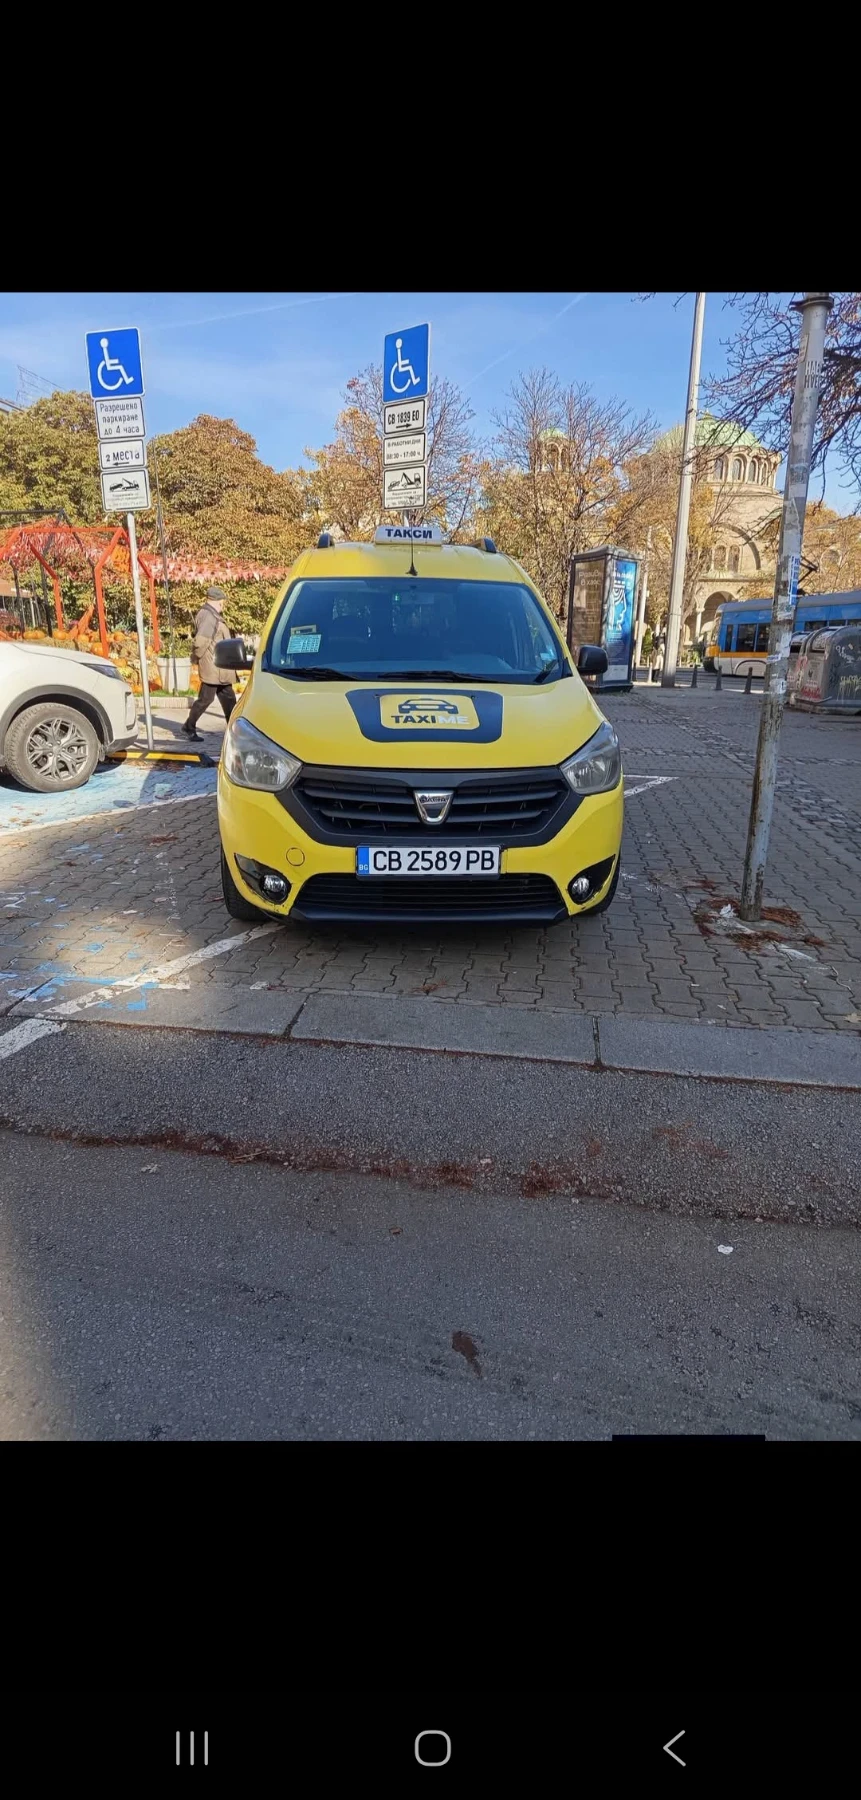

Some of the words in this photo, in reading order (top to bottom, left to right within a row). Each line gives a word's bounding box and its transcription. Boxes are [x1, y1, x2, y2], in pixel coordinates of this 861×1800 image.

[100, 403, 138, 413] Разрешено
[102, 414, 139, 424] паркиране
[388, 414, 396, 424] CB
[397, 411, 411, 424] 1839
[104, 428, 113, 436] до
[116, 425, 120, 434] 4
[385, 529, 432, 538] ТАКСИ
[373, 850, 402, 872] CB
[406, 850, 462, 872] 2589
[466, 850, 495, 871] PB
